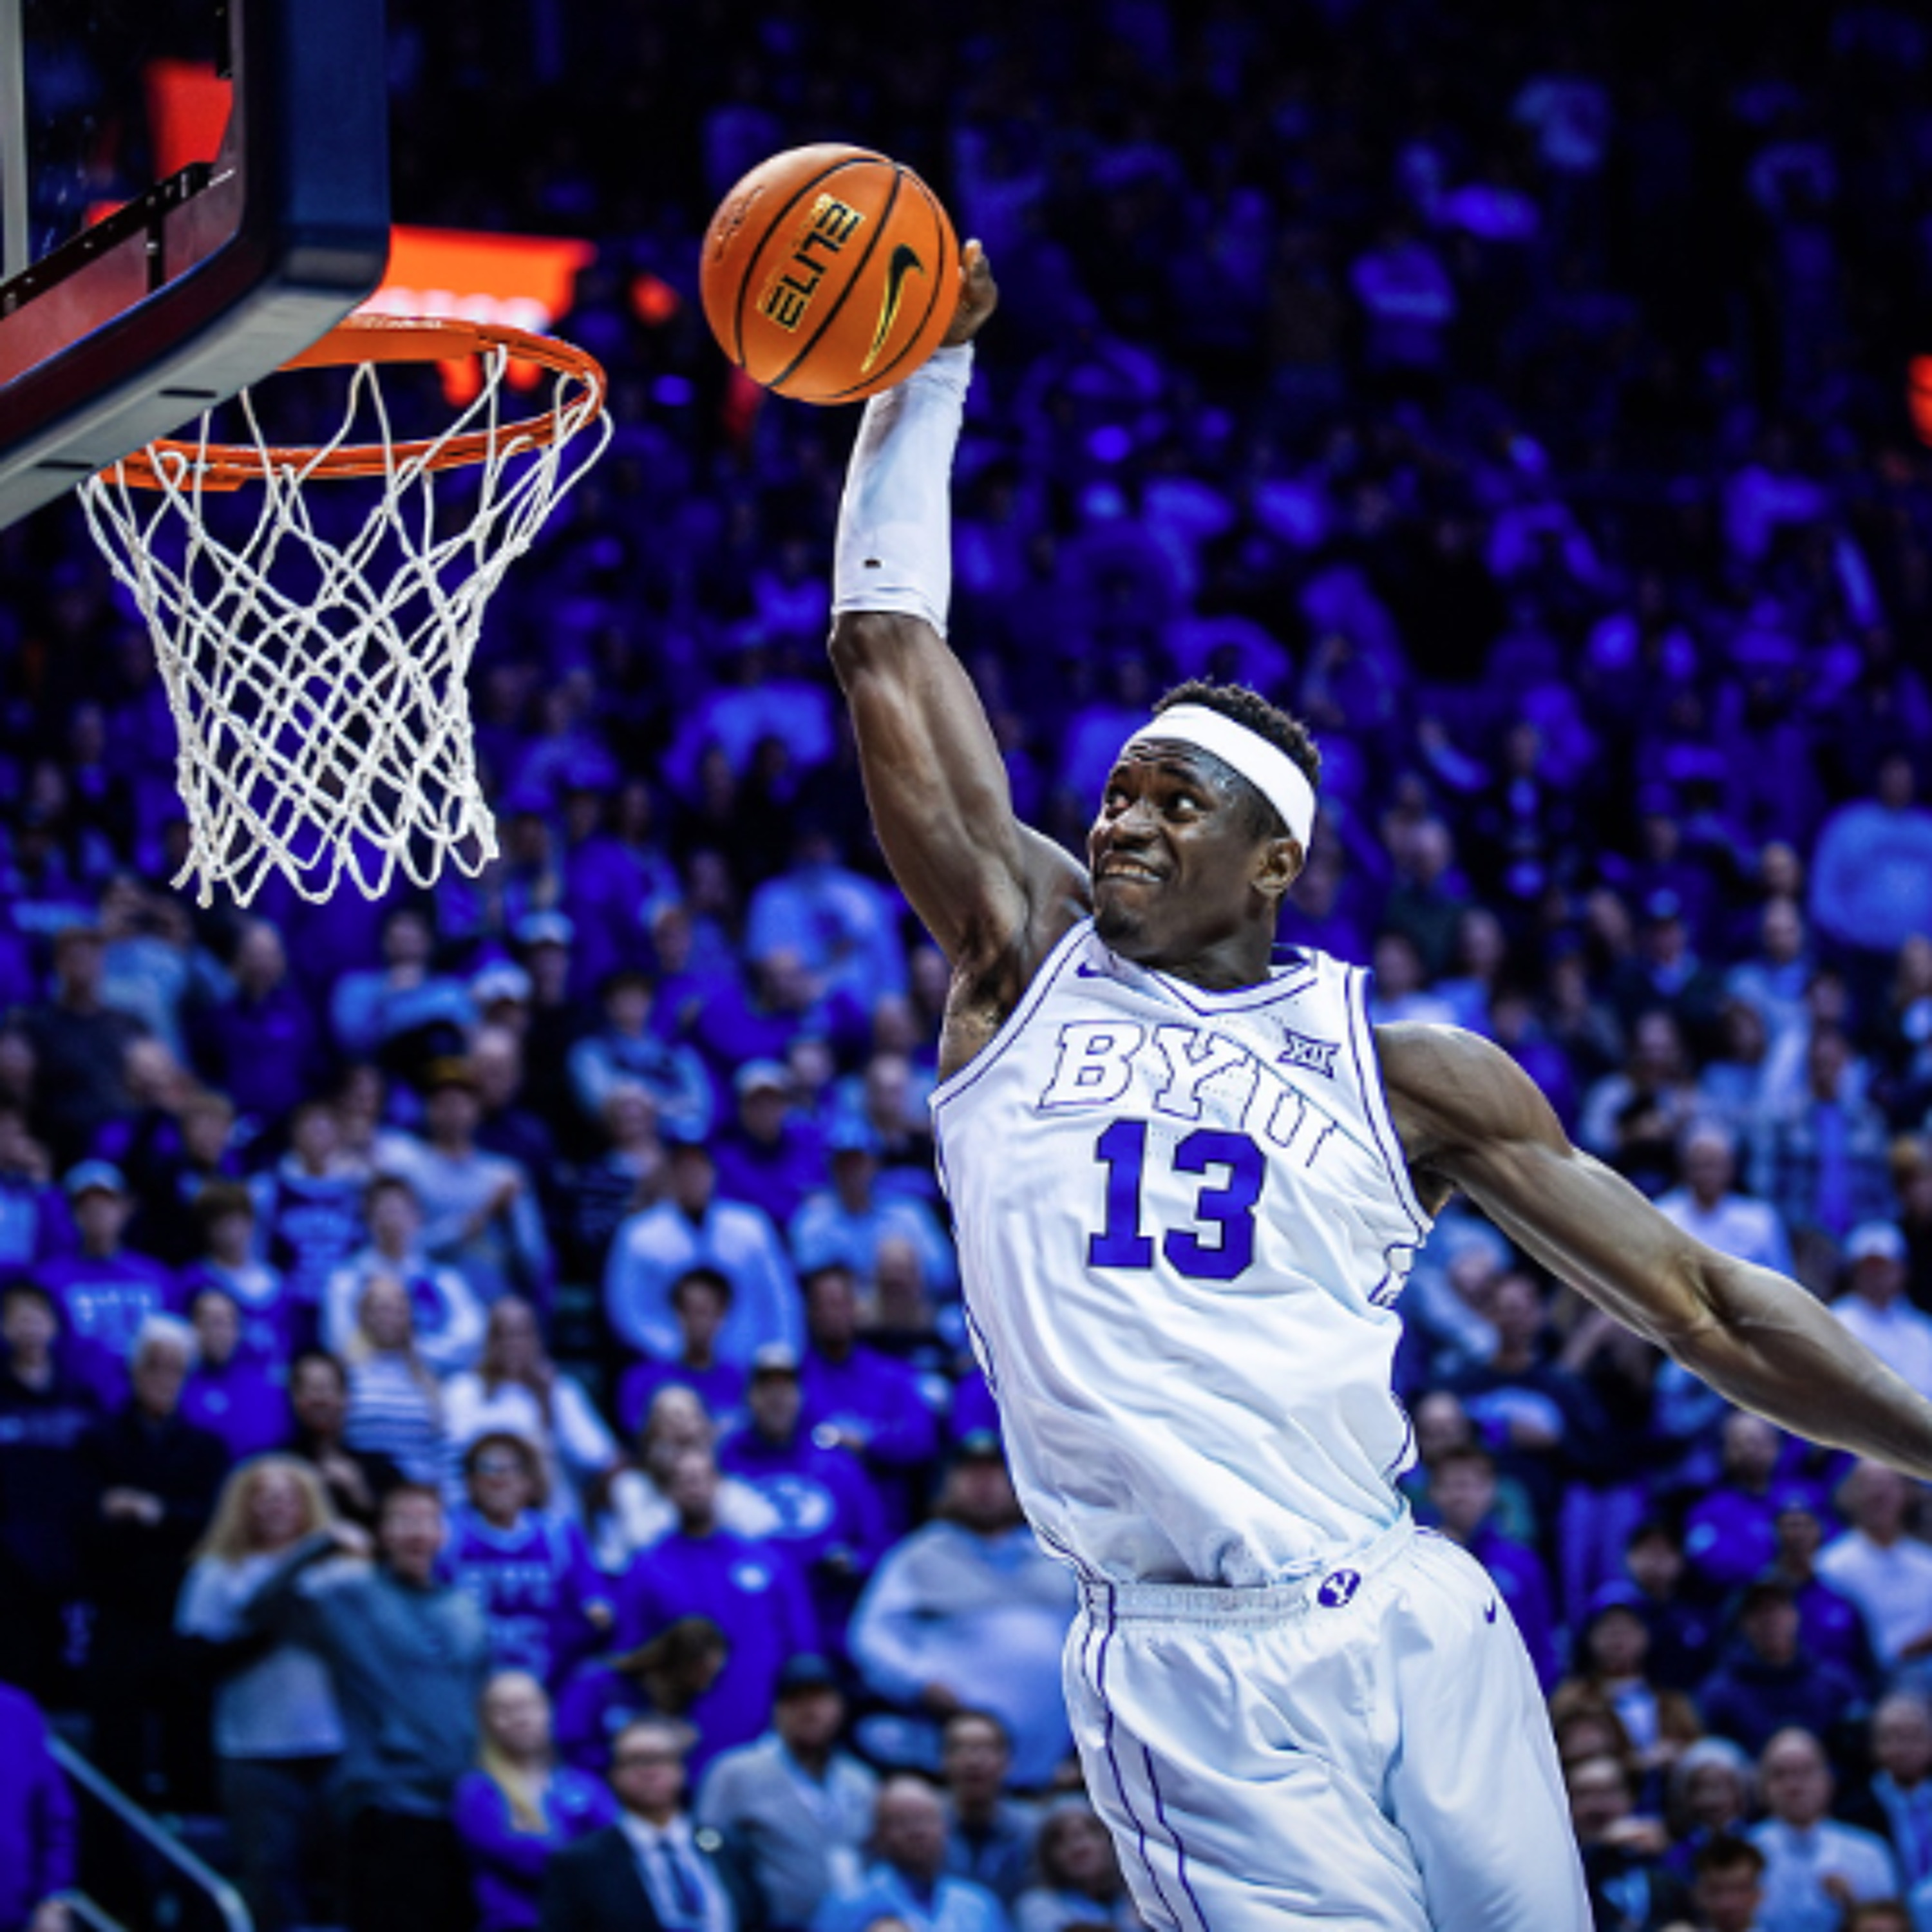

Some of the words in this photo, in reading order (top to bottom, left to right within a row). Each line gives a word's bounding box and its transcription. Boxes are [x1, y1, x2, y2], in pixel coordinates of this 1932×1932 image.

[761, 198, 862, 330] ELITE
[1036, 1021, 1338, 1168] BYU
[1087, 1117, 1268, 1282] 13
